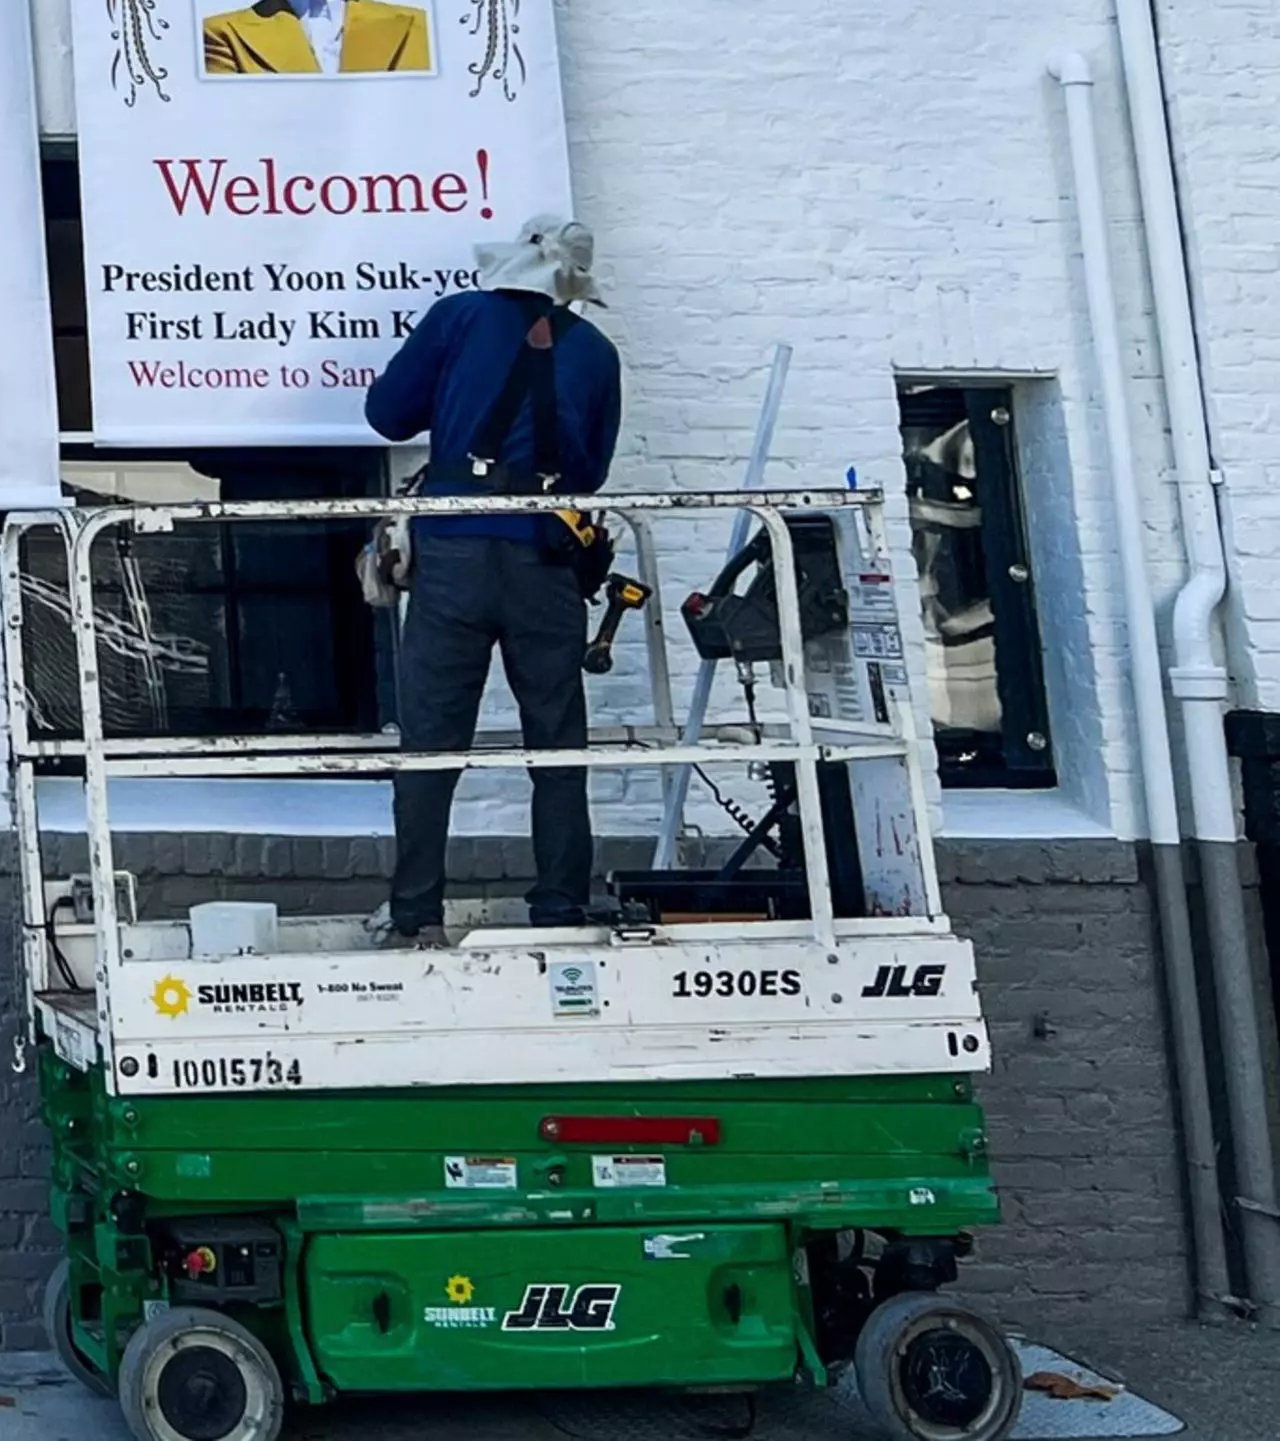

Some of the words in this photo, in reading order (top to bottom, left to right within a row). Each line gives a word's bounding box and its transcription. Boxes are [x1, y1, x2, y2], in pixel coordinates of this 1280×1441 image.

[153, 148, 493, 220] Welcome!
[102, 263, 255, 292] President
[263, 263, 346, 292] Yoon
[125, 311, 203, 340] First
[213, 311, 296, 347] Lady
[308, 310, 380, 339] Kim
[127, 360, 269, 388] Welcome
[280, 365, 310, 388] to
[321, 360, 377, 388] San
[197, 982, 304, 1006] SUNBELT
[672, 969, 801, 998] 1930ES
[860, 964, 946, 998] JLG
[173, 1058, 302, 1088] 10015734
[501, 1283, 621, 1331] JLG
